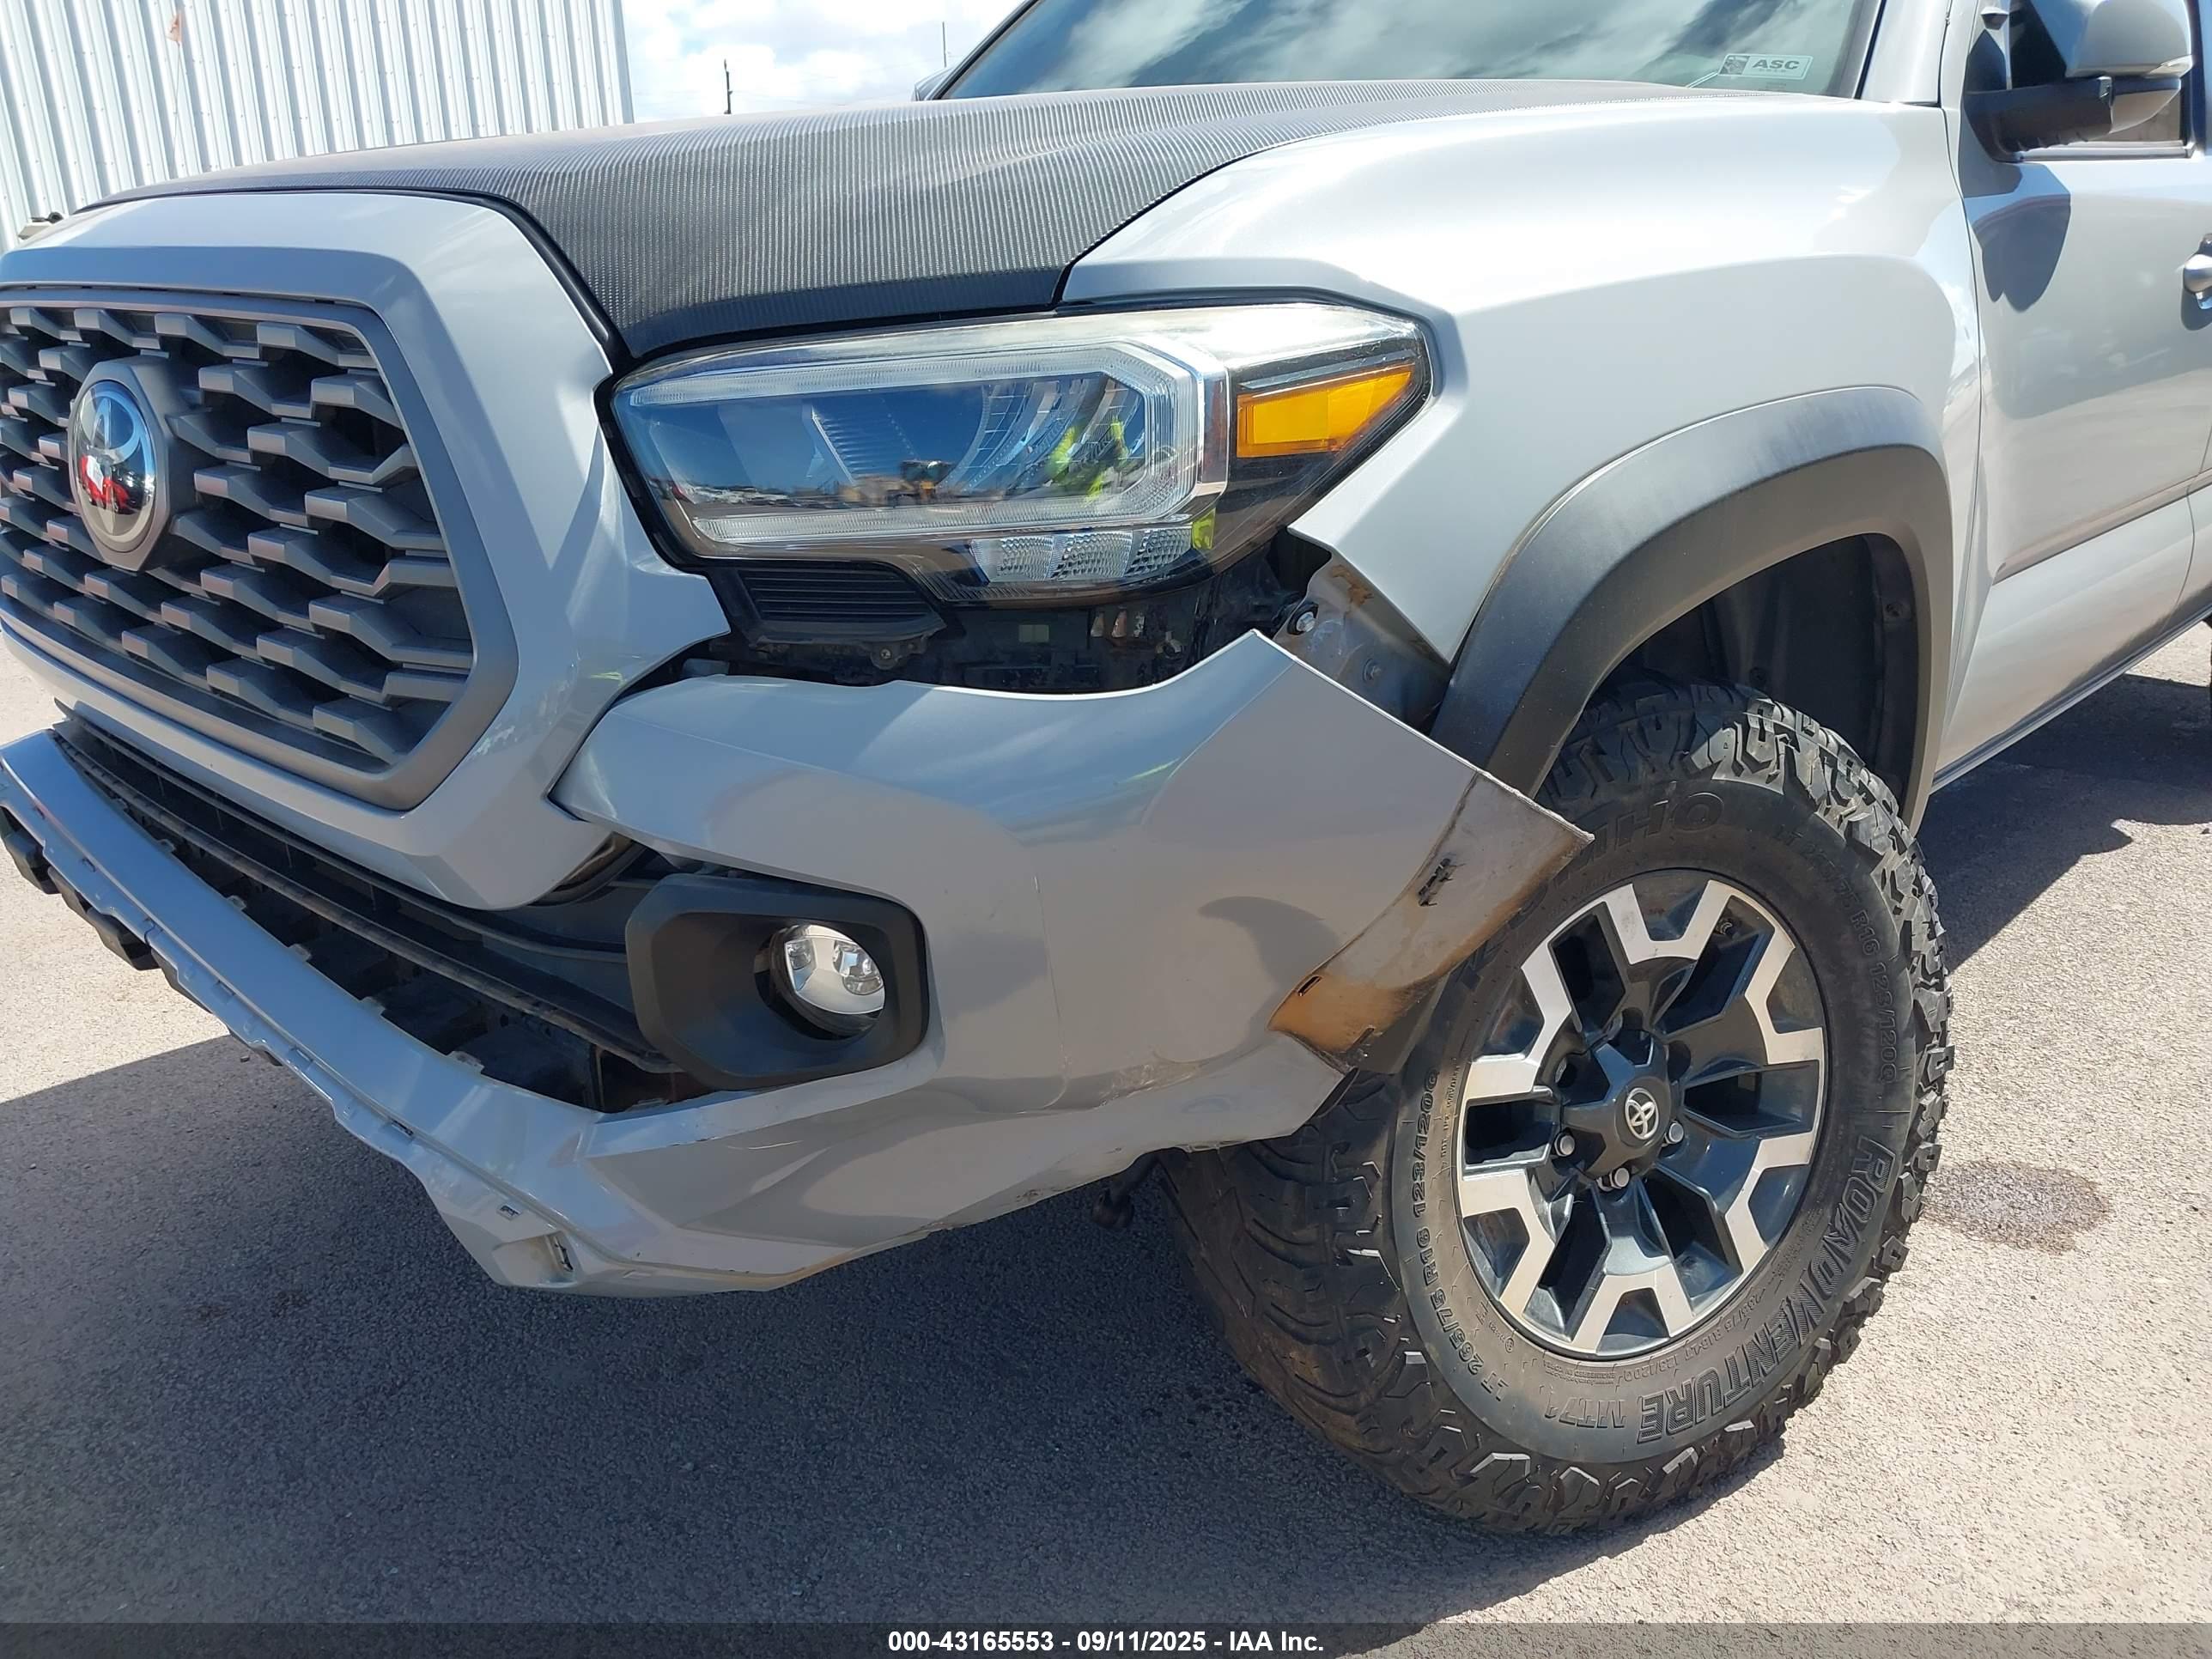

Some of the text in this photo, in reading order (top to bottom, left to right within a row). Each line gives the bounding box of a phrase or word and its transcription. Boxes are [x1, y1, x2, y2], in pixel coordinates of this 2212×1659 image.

[1753, 59, 1800, 70] ASC
[1851, 909, 1880, 957] R16
[1869, 962, 1897, 1085] 123/120Q
[1412, 1069, 1440, 1218] 123/120Q
[1417, 1227, 1439, 1286] R16
[1430, 1288, 1484, 1375] 265/75
[1481, 1372, 1509, 1401] LT
[1544, 1389, 1627, 1429] MT71
